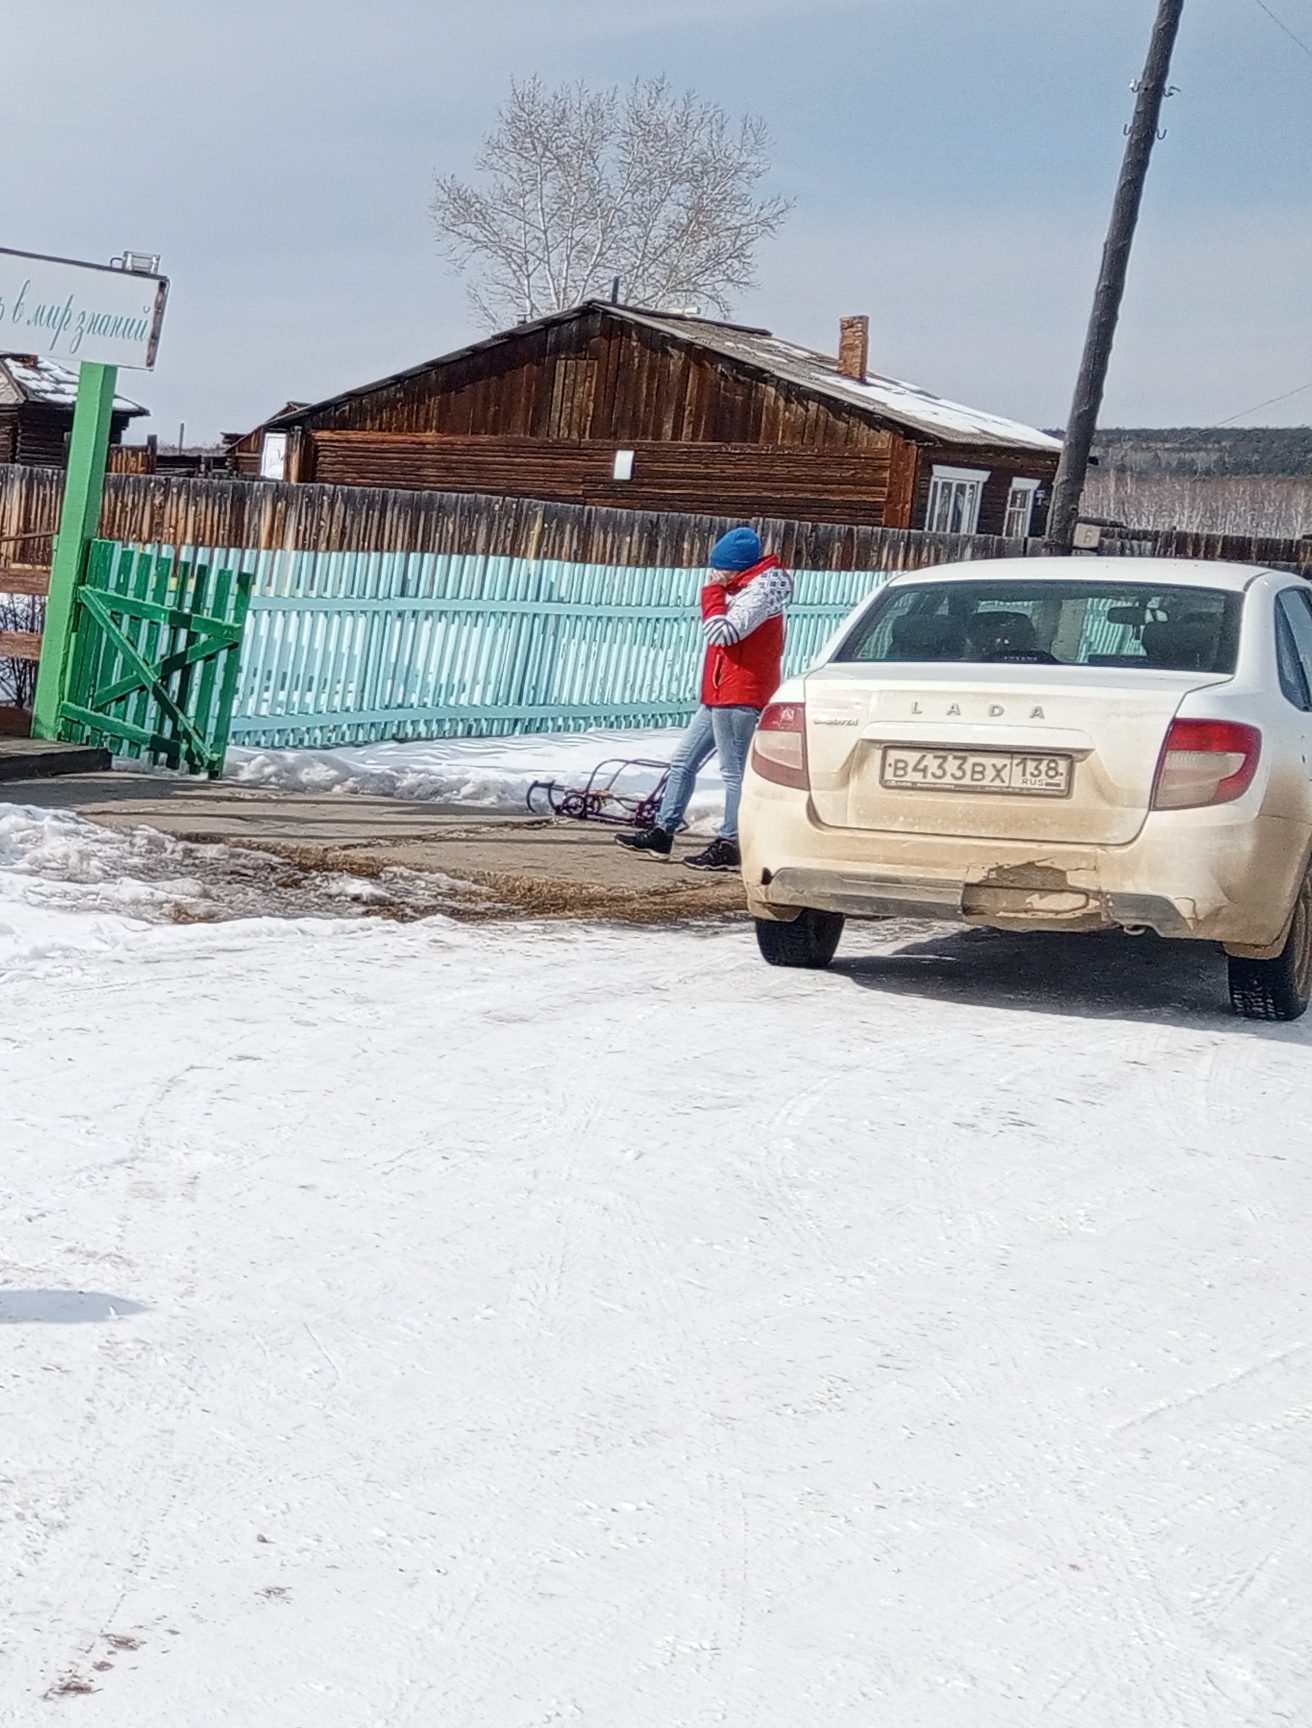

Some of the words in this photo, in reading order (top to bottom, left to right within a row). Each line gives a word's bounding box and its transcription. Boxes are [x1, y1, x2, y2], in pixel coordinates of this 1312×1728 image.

[12, 279, 31, 323] в
[27, 295, 74, 351] мир
[70, 304, 151, 354] знаний
[911, 702, 1045, 719] LADA
[1022, 777, 1044, 787] RUS
